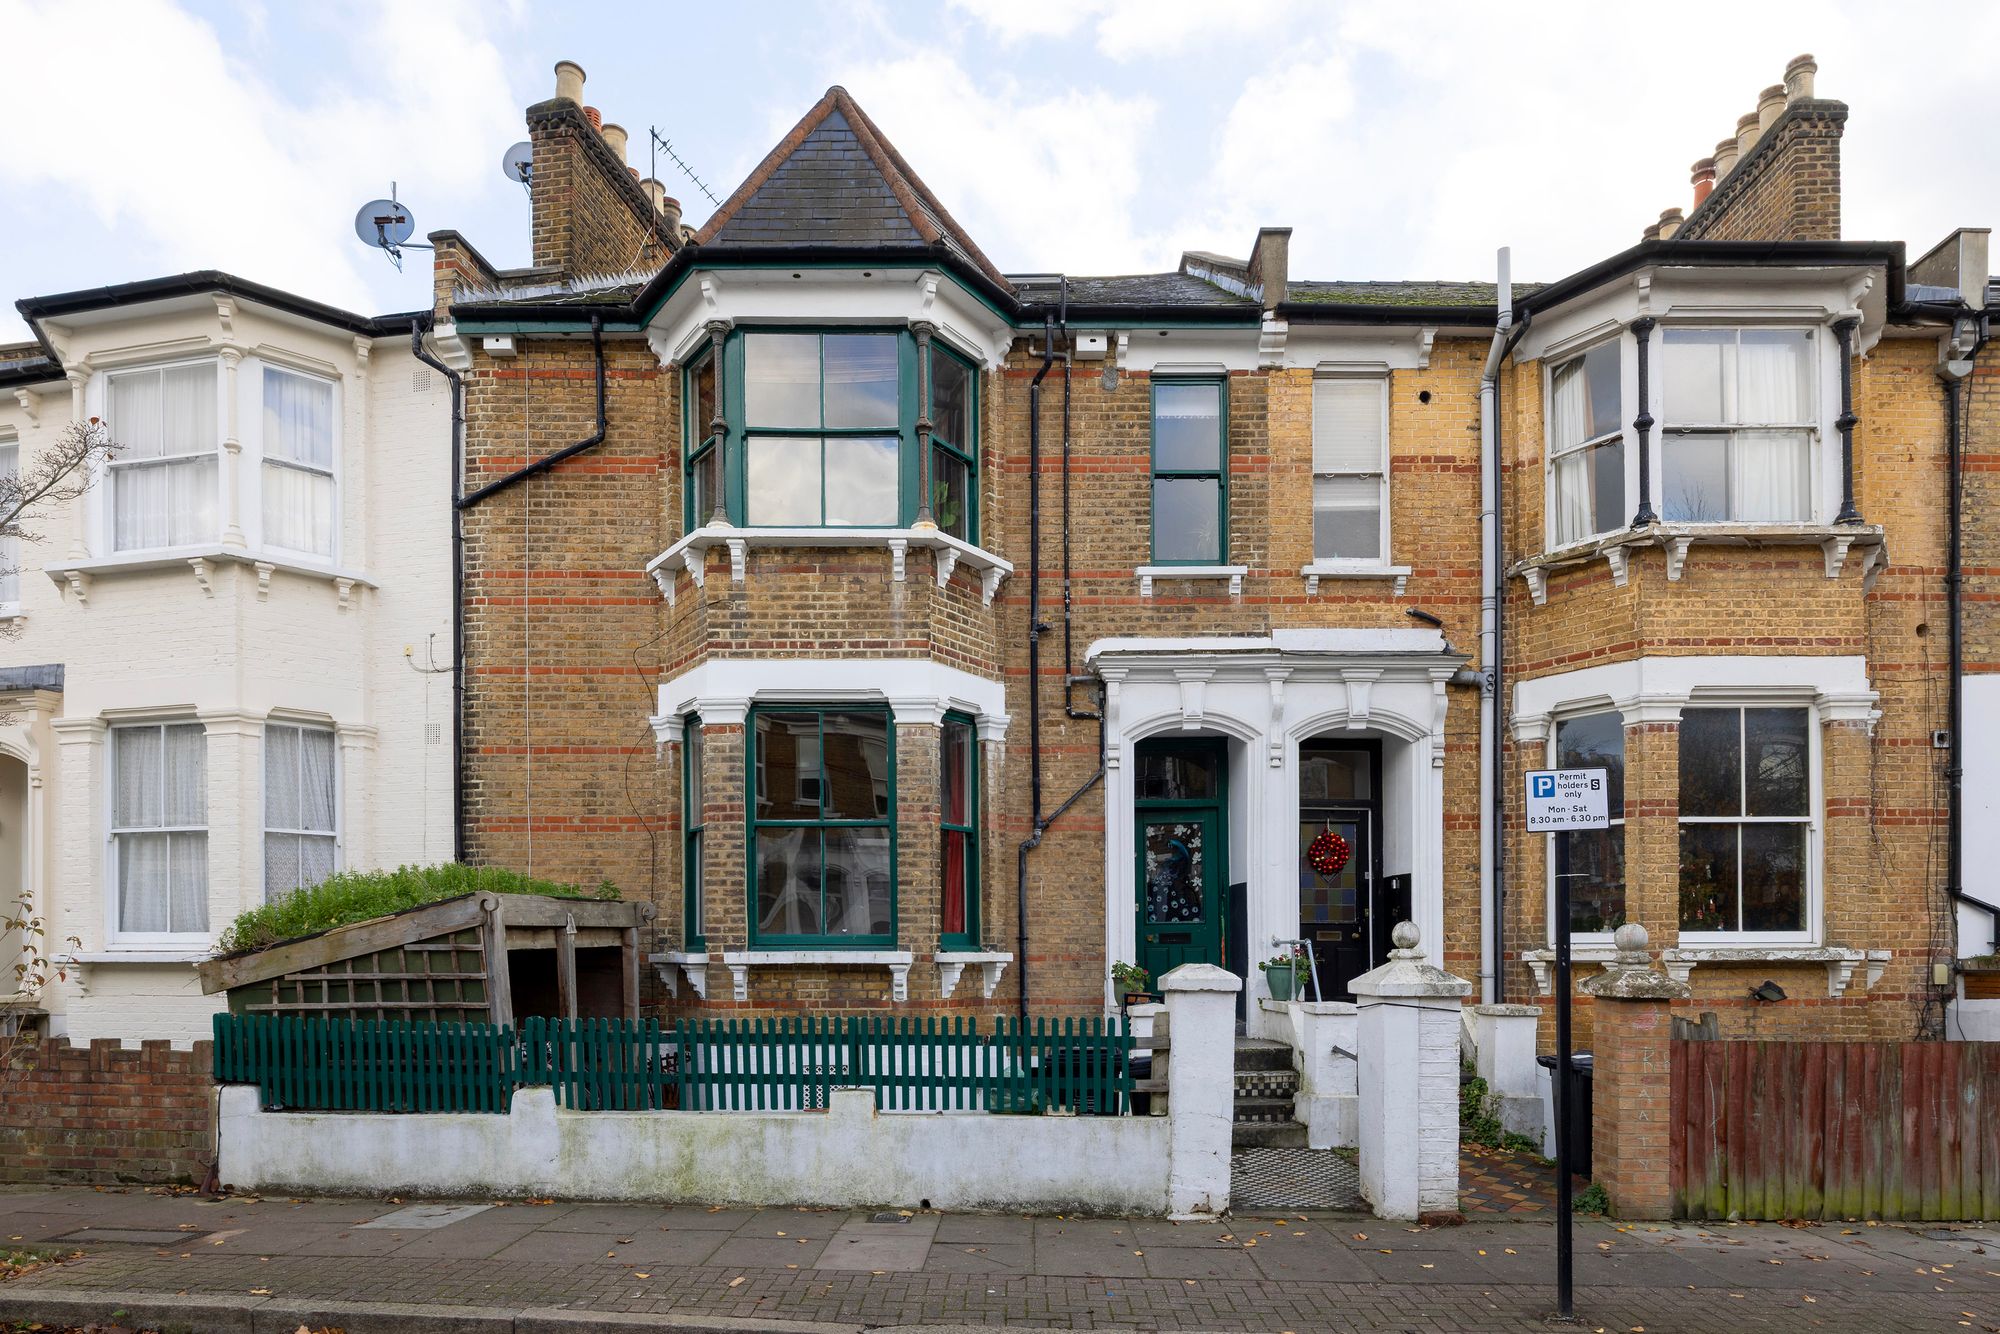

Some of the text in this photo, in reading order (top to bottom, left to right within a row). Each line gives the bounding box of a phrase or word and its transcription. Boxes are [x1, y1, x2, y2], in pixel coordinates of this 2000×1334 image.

[1559, 773, 1587, 781] Permit
[1538, 778, 1552, 796] P
[1557, 781, 1589, 790] holders
[1592, 780, 1599, 789] S
[1530, 816, 1551, 824] 8.30
